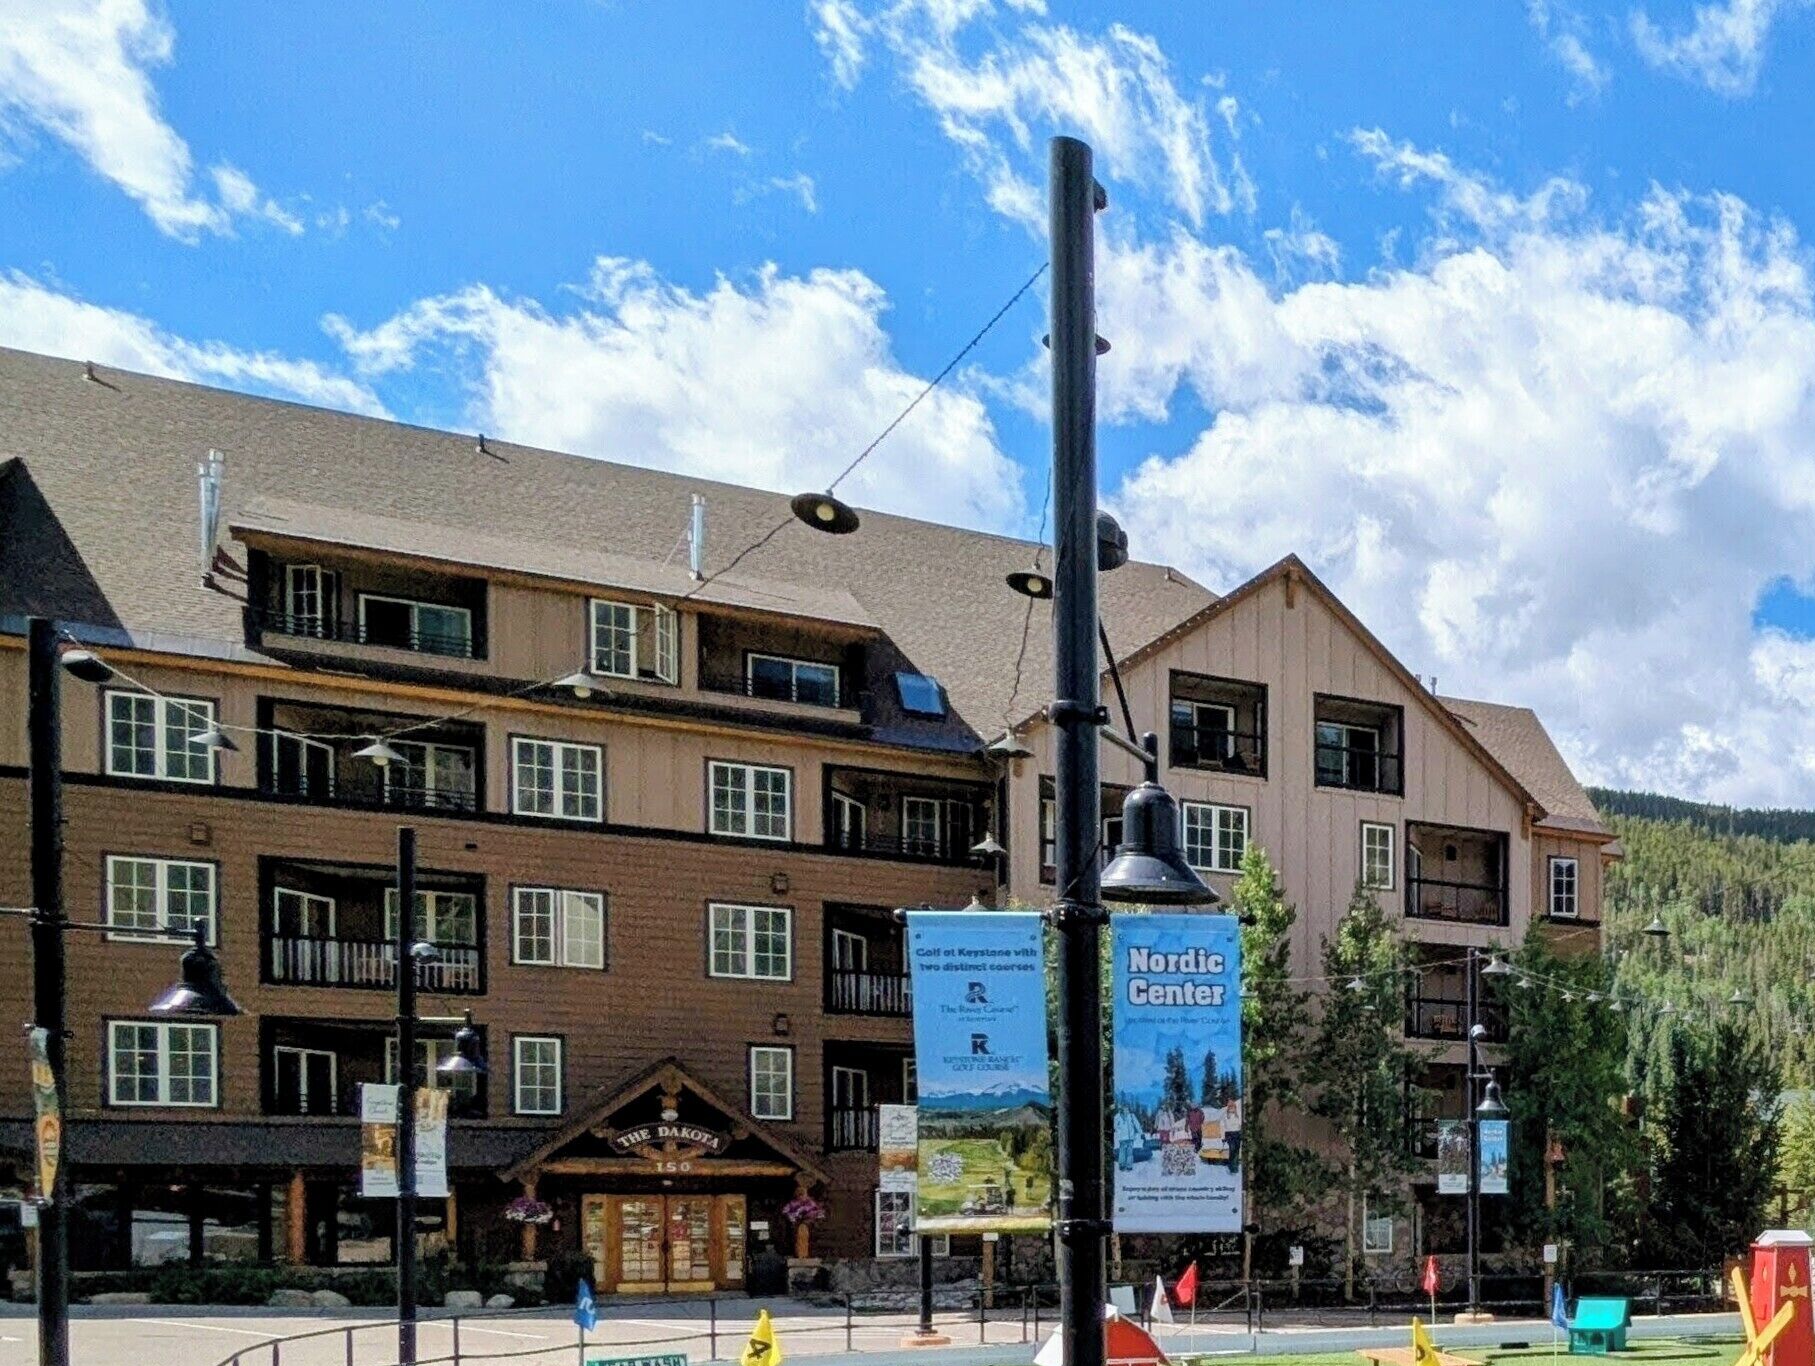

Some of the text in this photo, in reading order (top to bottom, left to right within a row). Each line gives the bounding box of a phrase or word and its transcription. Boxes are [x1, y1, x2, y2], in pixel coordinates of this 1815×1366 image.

[915, 947, 1037, 959] Golf at Keystone with
[1128, 946, 1225, 975] Nordic
[942, 962, 987, 972] distinct
[989, 964, 1035, 972] courses
[1128, 977, 1225, 1006] Center
[941, 1004, 957, 1014] The
[617, 1125, 719, 1149] THE DAKOTA
[656, 1161, 690, 1172] 150
[747, 1338, 772, 1359] 4
